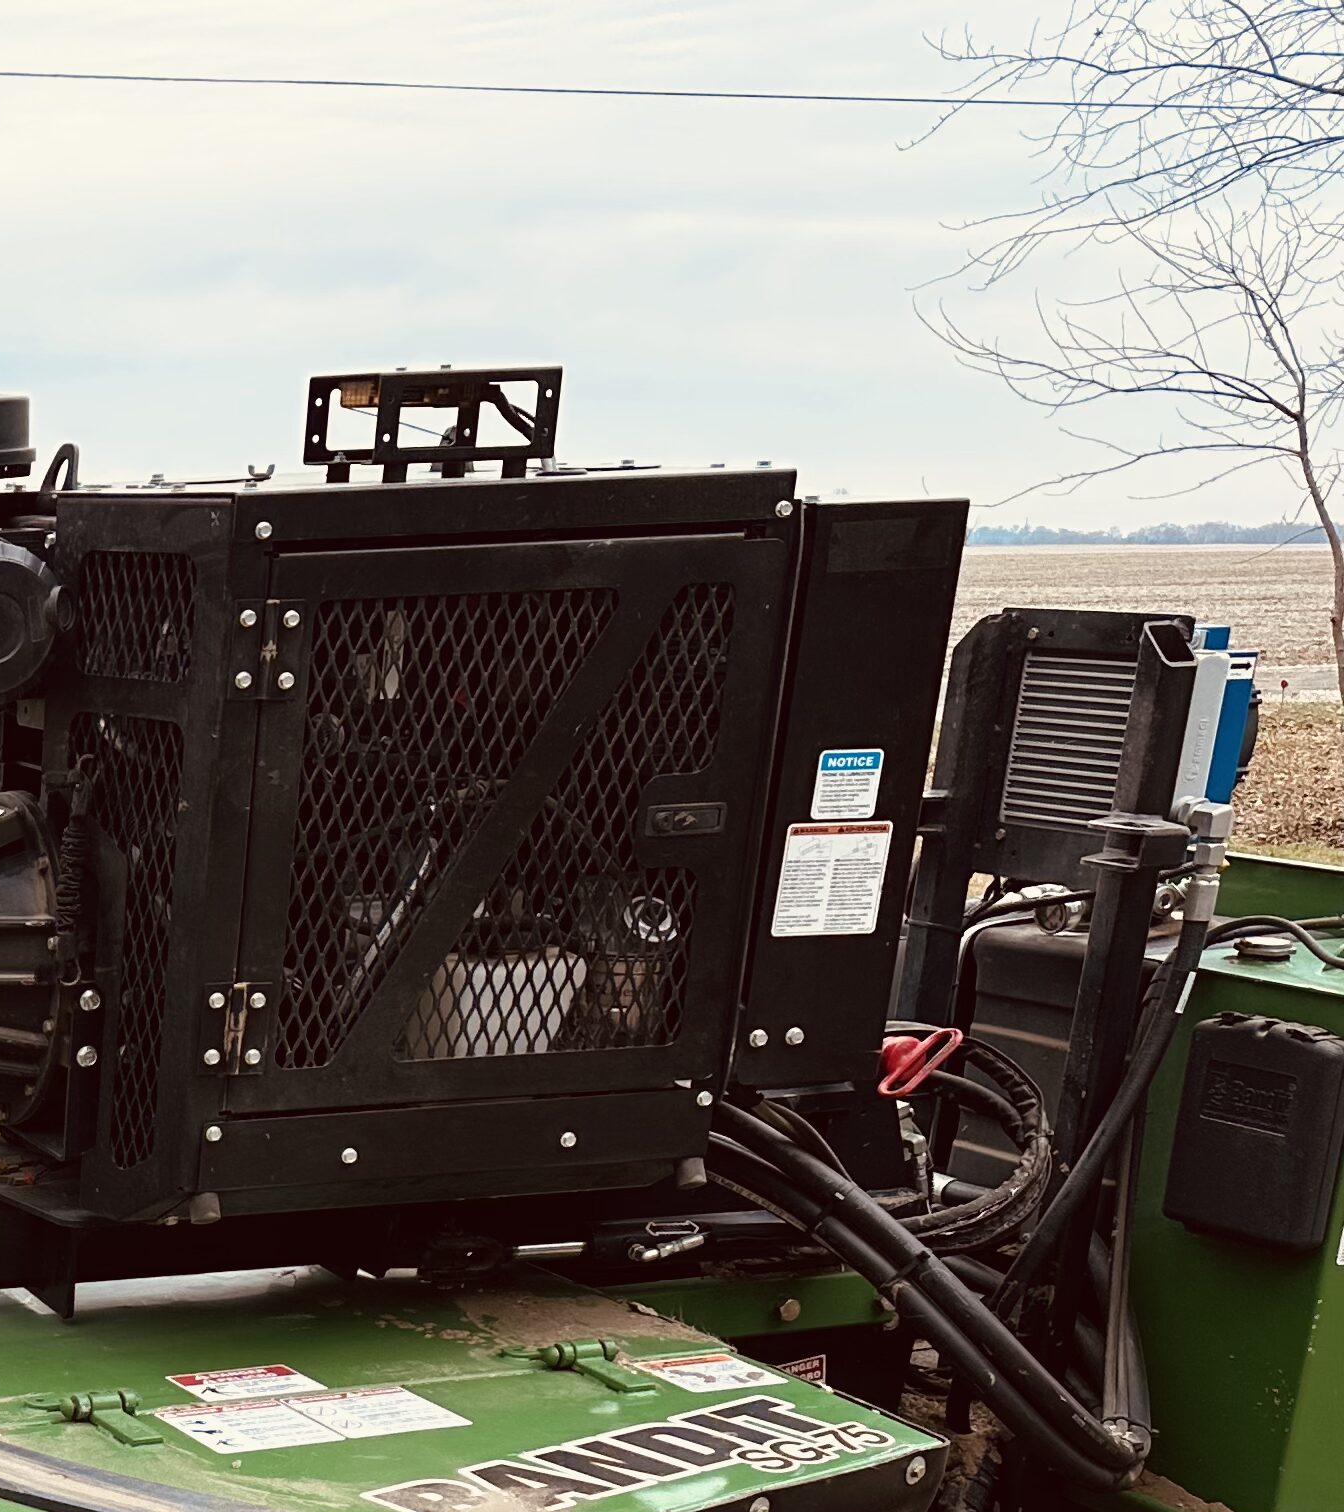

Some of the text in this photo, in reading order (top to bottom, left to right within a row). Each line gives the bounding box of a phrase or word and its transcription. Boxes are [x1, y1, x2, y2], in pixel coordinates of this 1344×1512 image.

[827, 756, 874, 767] NOTICE
[784, 1359, 820, 1374] ANGER
[735, 1425, 890, 1471] SG-75
